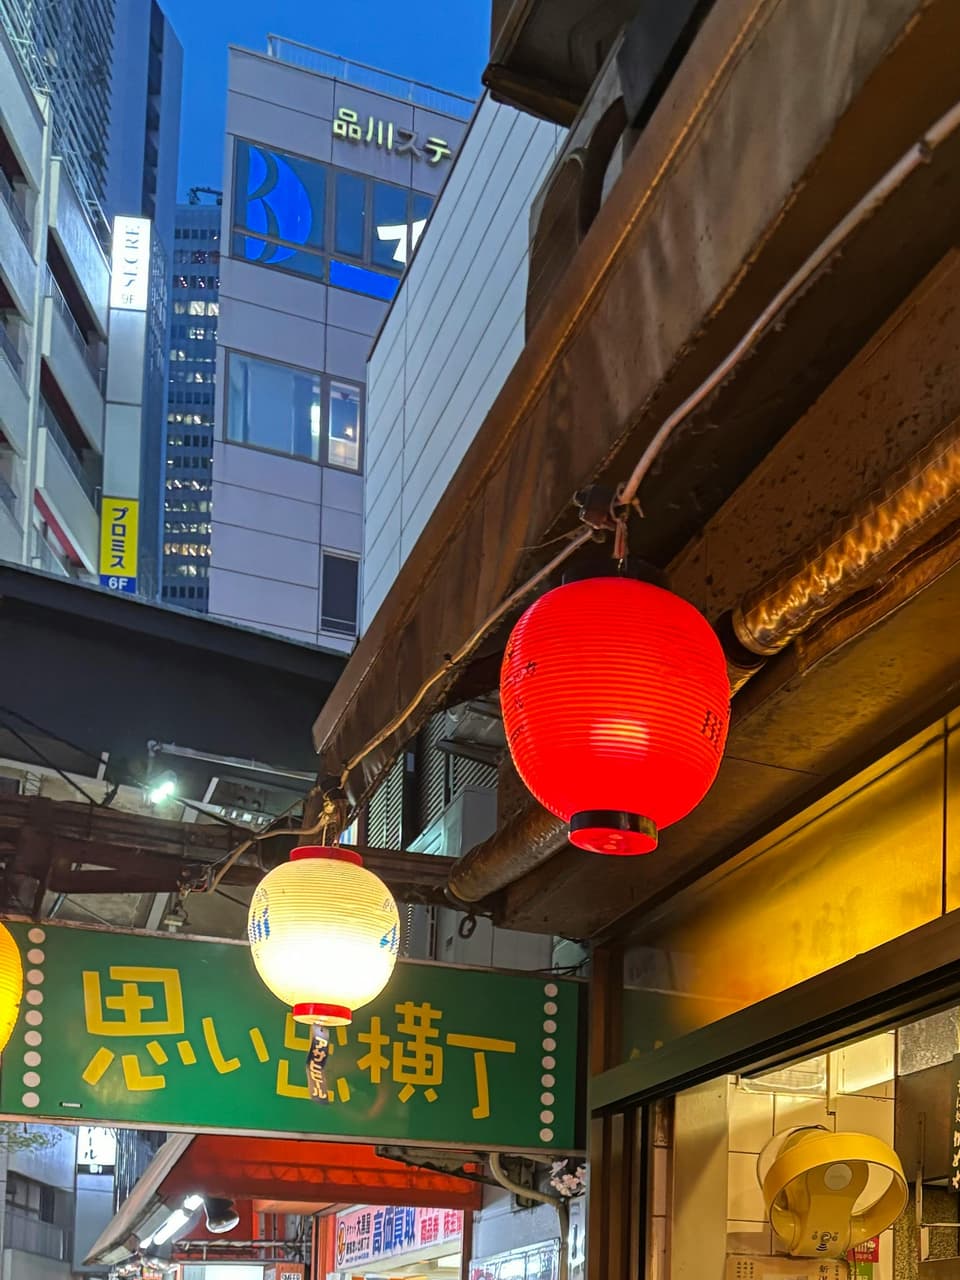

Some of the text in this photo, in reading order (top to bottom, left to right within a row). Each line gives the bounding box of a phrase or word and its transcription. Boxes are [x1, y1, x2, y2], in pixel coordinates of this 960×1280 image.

[333, 107, 452, 163] 品川ステ
[111, 506, 129, 569] プロミス
[108, 577, 128, 590] 6F
[85, 1128, 97, 1160] ール
